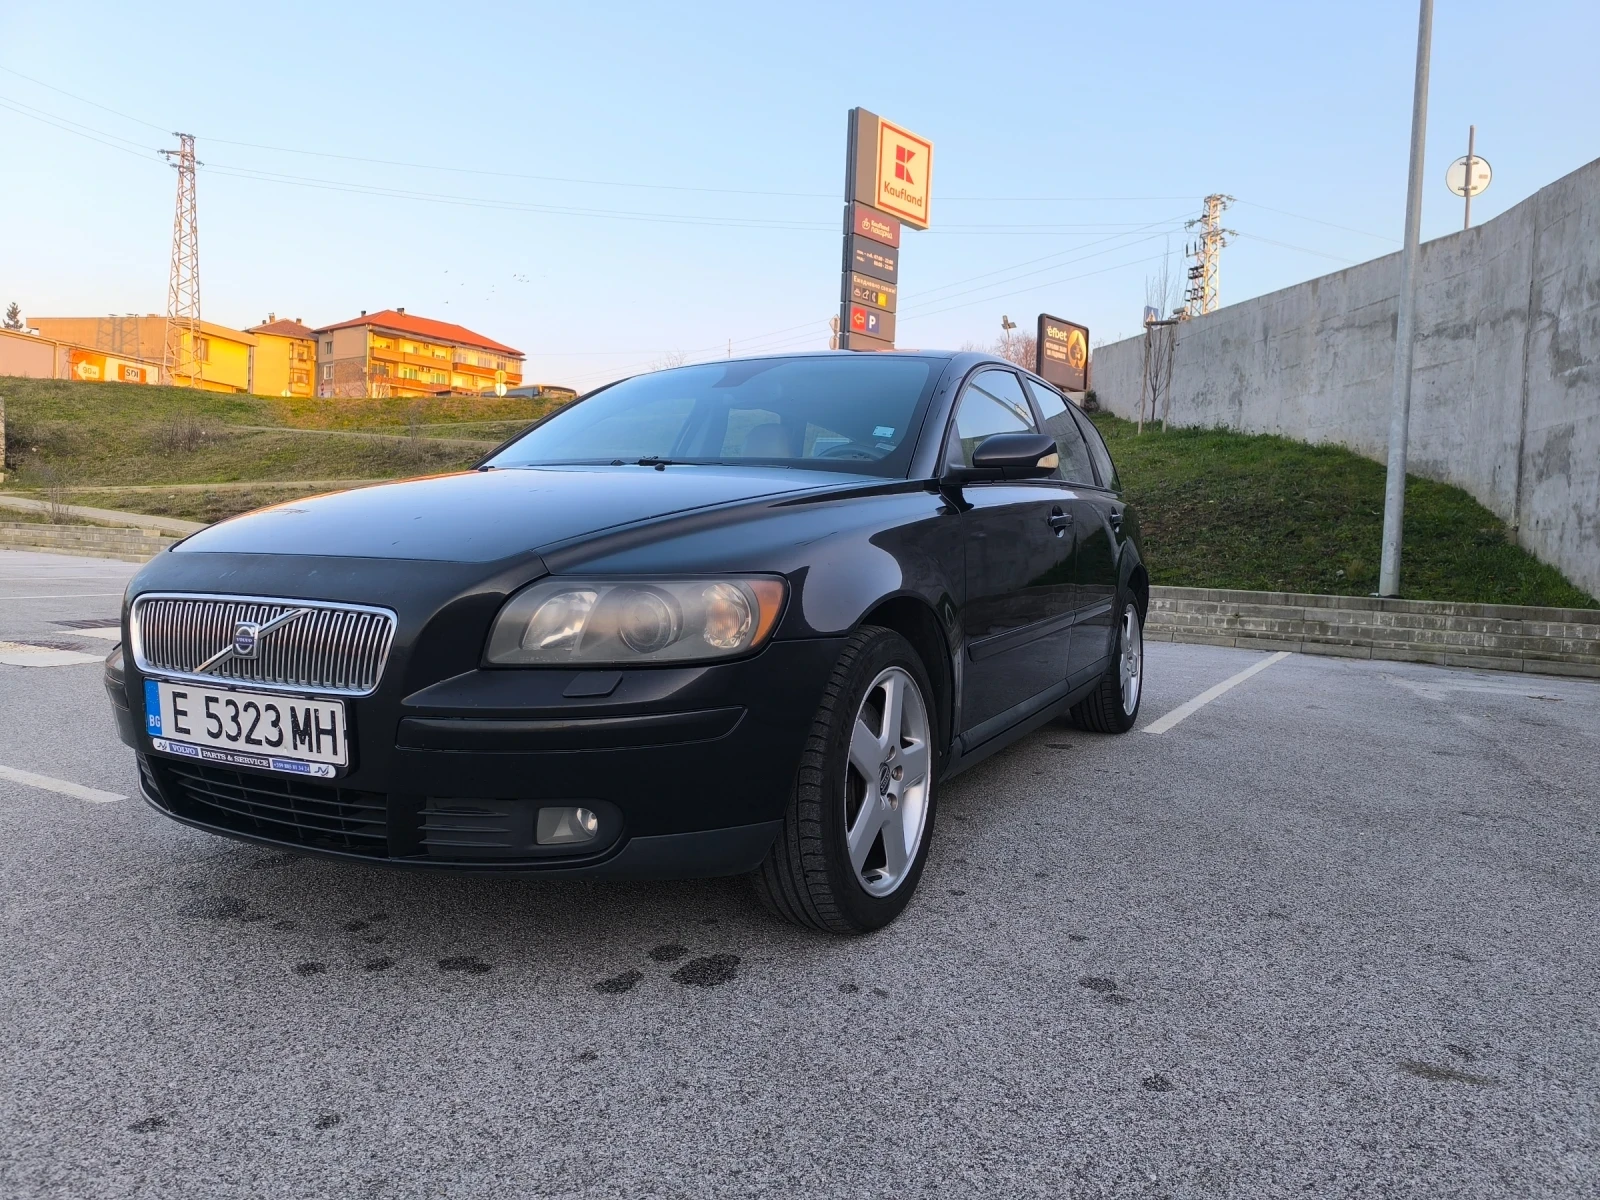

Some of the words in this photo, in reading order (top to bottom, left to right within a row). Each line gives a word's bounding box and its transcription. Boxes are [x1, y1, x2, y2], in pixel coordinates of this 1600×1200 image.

[884, 180, 922, 207] Kaufland
[854, 276, 880, 290] Ежедневно
[868, 314, 877, 329] P
[1047, 326, 1068, 341] efbet
[125, 368, 139, 378] SDI
[149, 714, 161, 728] BG
[171, 690, 191, 735] E
[204, 695, 284, 748] 5323
[289, 705, 338, 756] MH
[171, 744, 196, 755] VOLVO
[202, 750, 226, 760] PARTS
[234, 755, 269, 767] SERVICE
